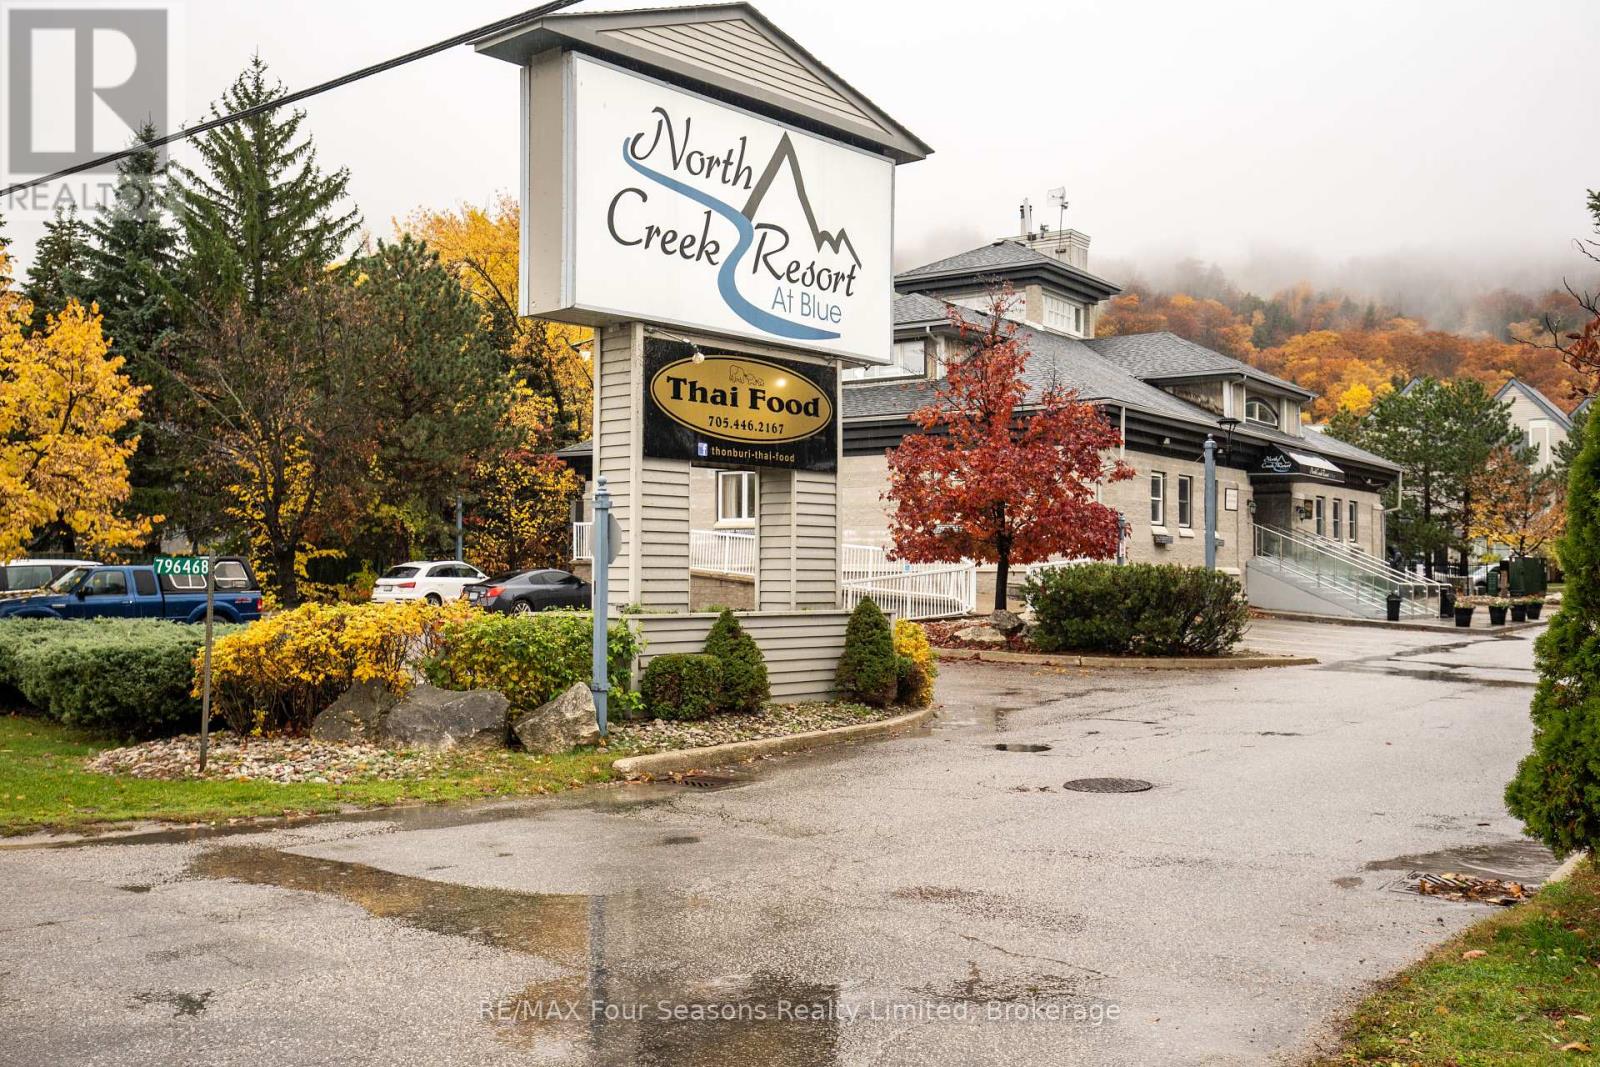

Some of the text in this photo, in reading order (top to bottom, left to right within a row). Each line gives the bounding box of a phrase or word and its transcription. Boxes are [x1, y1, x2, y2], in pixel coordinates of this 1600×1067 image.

[630, 106, 753, 190] North
[607, 187, 857, 297] Creek Resort
[772, 286, 842, 324] At Blue
[666, 376, 820, 418] Thai Food
[708, 415, 784, 435] 705.446.2167
[711, 446, 795, 463] thonburi-thai-food
[155, 559, 209, 574] 796468
